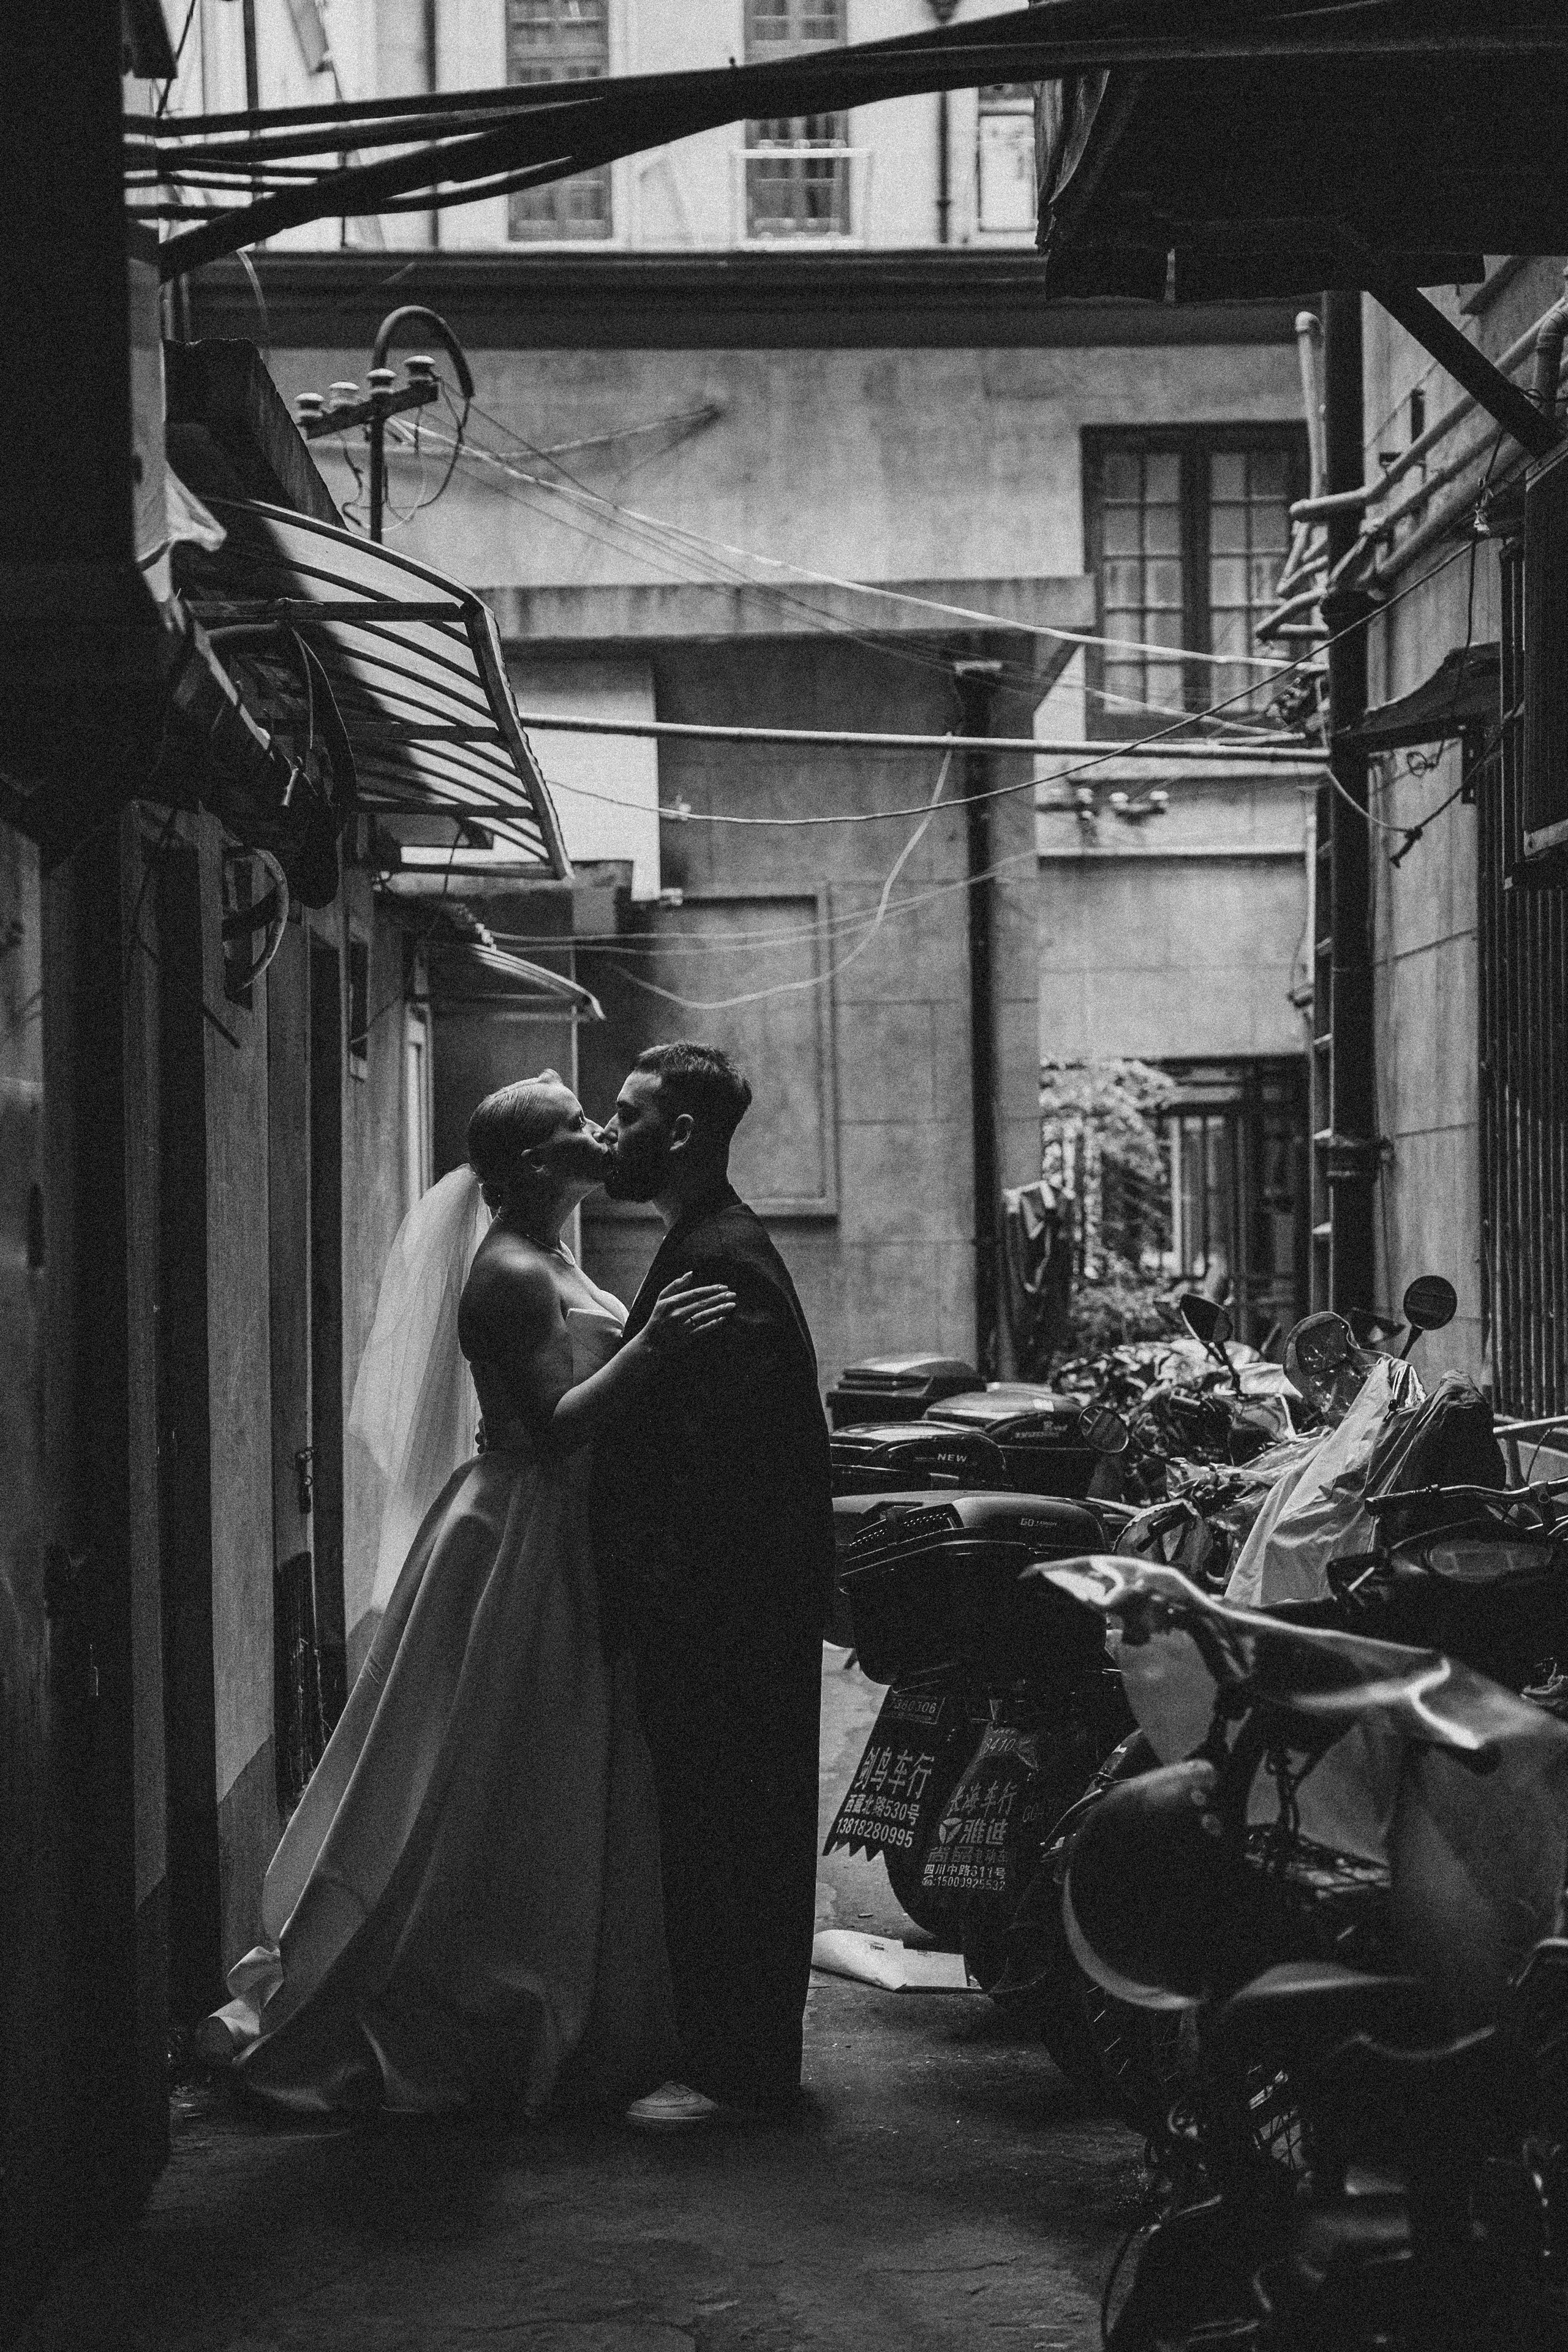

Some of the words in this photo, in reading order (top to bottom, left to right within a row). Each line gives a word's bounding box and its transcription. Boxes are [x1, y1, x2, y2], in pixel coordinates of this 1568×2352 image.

[937, 1453, 968, 1463] NEW
[835, 1816, 915, 1849] 13818280995
[959, 1817, 1009, 1845] 雅迪
